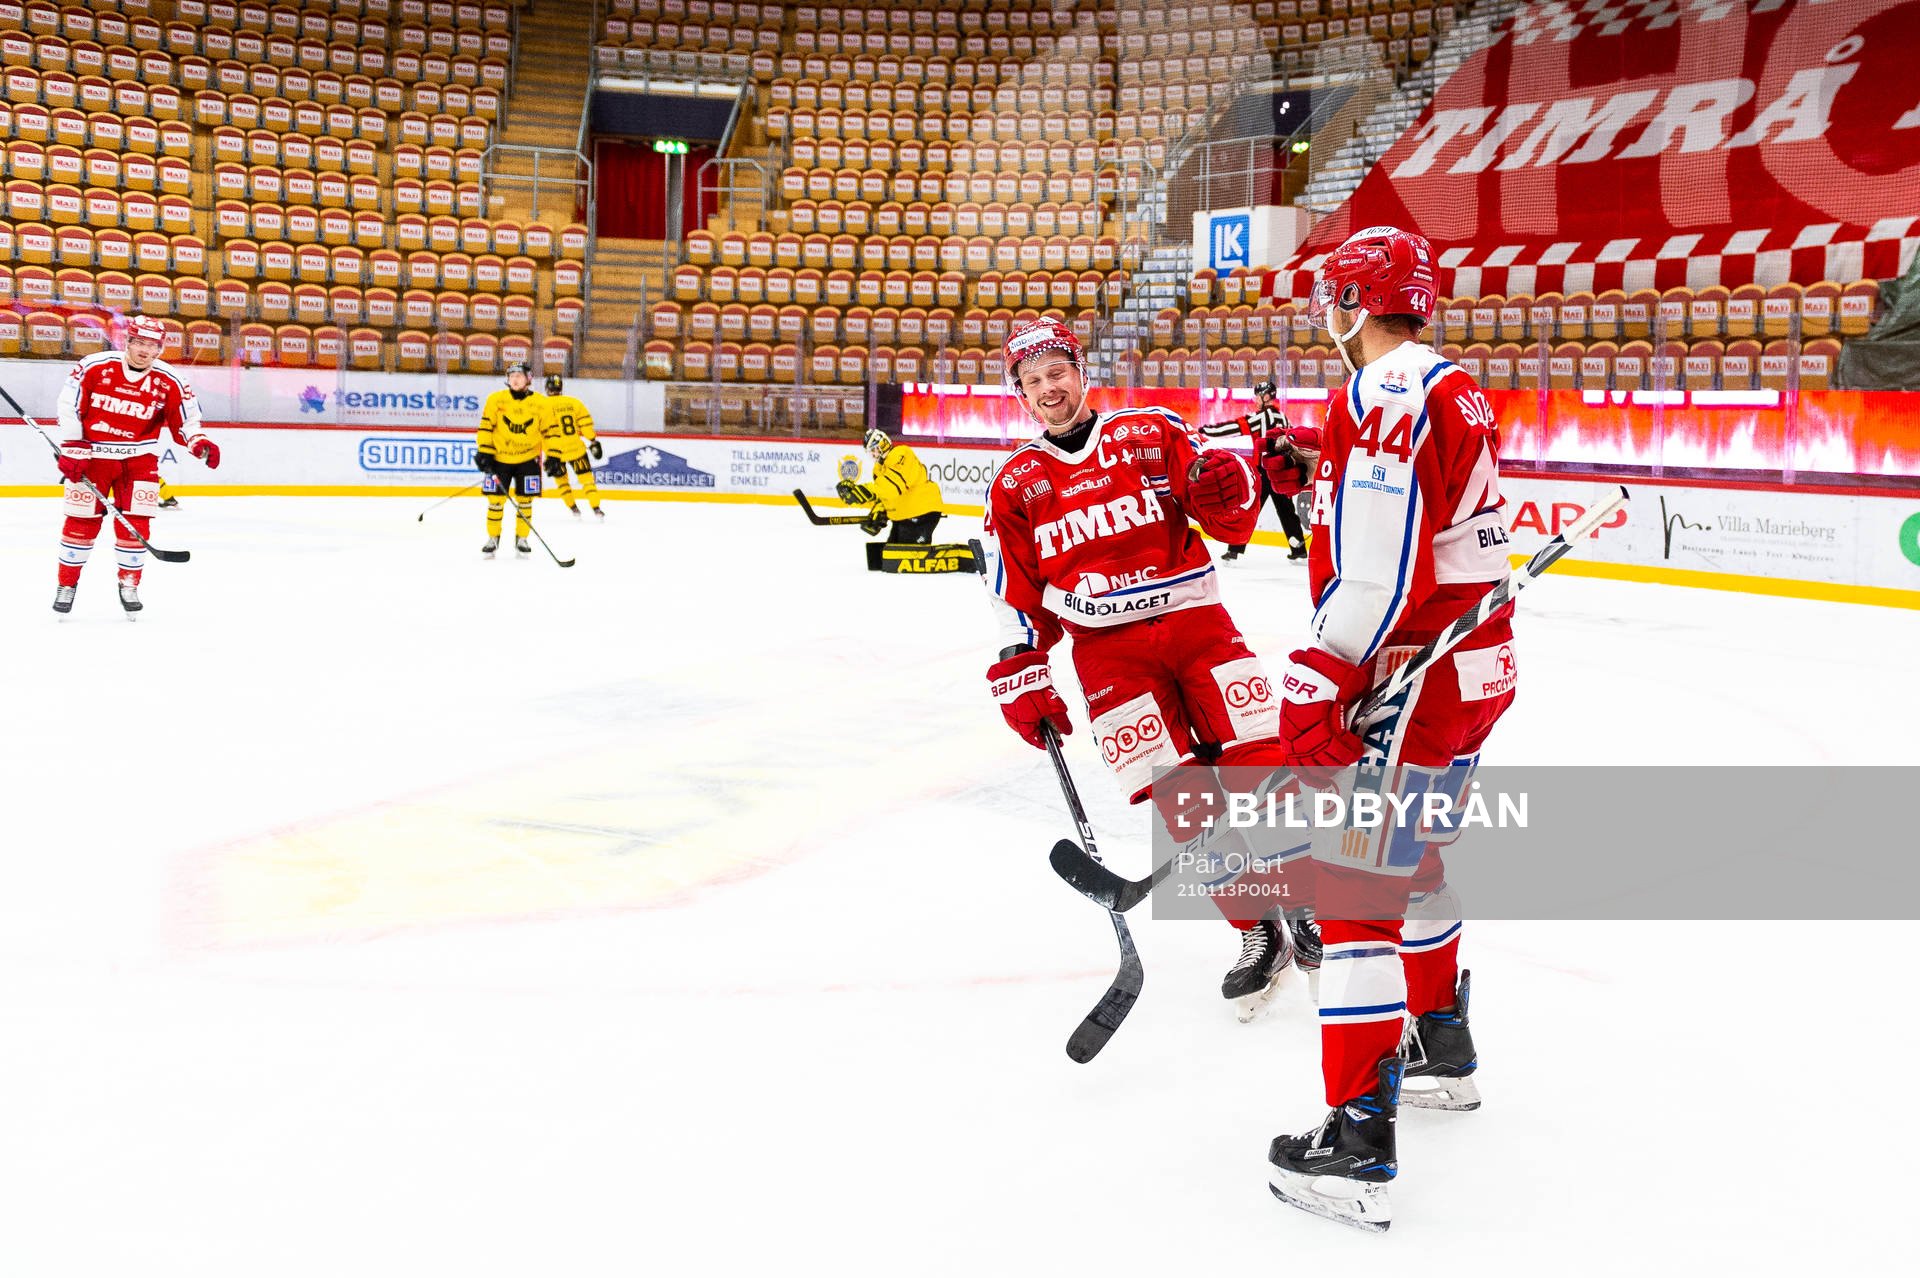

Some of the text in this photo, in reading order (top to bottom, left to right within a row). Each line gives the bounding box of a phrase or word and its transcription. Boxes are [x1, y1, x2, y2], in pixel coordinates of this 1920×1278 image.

[1390, 36, 1862, 179] TIMRÅ
[1215, 223, 1243, 269] LK
[1410, 292, 1426, 312] 44
[1805, 303, 1827, 313] MAXI
[1843, 303, 1866, 311] MAXI
[1624, 306, 1646, 317] MAXI
[1661, 308, 1680, 317] MAXI
[1730, 306, 1750, 315] MAXI
[1767, 305, 1788, 313] MAXI
[1475, 314, 1492, 322] MAXI
[1503, 314, 1520, 322] MAXI
[1534, 311, 1550, 320] MAXI
[1564, 311, 1582, 320] MAXI
[1491, 364, 1508, 373] MAXI
[1552, 362, 1570, 371] MAXI
[1584, 363, 1603, 372] MAXI
[1618, 362, 1638, 372] MAXI
[1688, 362, 1708, 372] MAXI
[1725, 362, 1746, 371] MAXI
[1765, 360, 1786, 372] MAXI
[1803, 360, 1826, 372] MAXI
[334, 388, 480, 410] teamsters
[90, 392, 156, 420] TIMRÅ
[110, 427, 136, 439] NHC
[1132, 424, 1160, 435] SCA
[1353, 406, 1413, 464] 44
[732, 450, 803, 462] TILLSAMMANS
[1097, 434, 1118, 469] C
[731, 463, 806, 474] DET OMÖJLIGA
[1012, 459, 1041, 476] SCA
[731, 476, 768, 486] ENKELT
[1061, 475, 1112, 498] stadium
[1034, 474, 1165, 560] TIMRÅ
[1718, 516, 1836, 541] Villa Marieberg
[898, 558, 959, 572] ALFAB
[1110, 566, 1159, 590] NHC
[1064, 592, 1170, 616] BILBOLAGET
[991, 668, 1049, 697] BAUER
[1102, 714, 1162, 763] LBM
